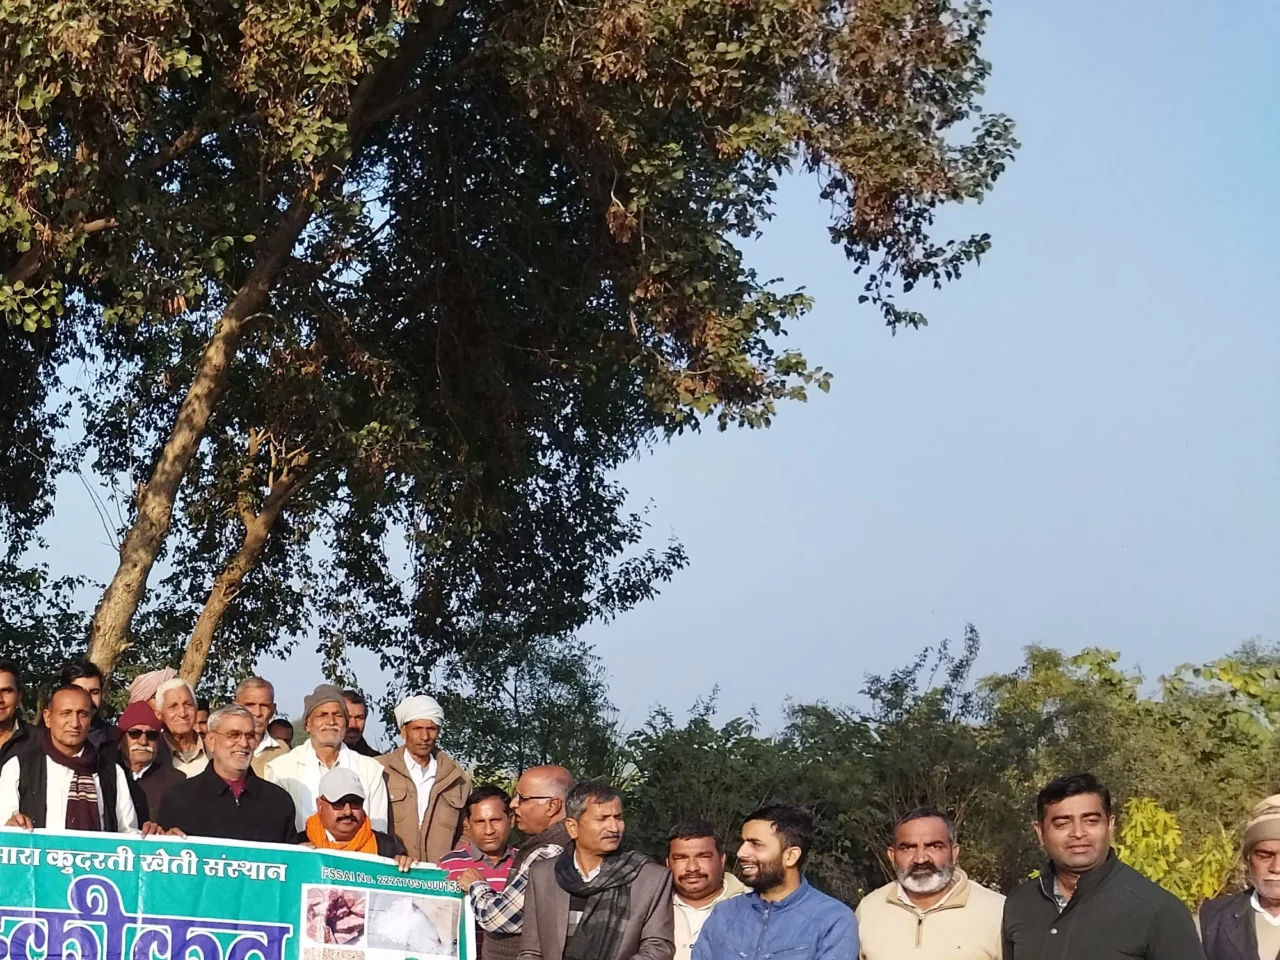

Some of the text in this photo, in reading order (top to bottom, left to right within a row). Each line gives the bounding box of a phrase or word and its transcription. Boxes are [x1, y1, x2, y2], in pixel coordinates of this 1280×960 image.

[46, 846, 135, 875] कुदरती
[140, 850, 198, 876] खेती
[202, 853, 287, 882] संस्थान
[321, 866, 355, 882] FSSAI
[357, 872, 376, 885] No.
